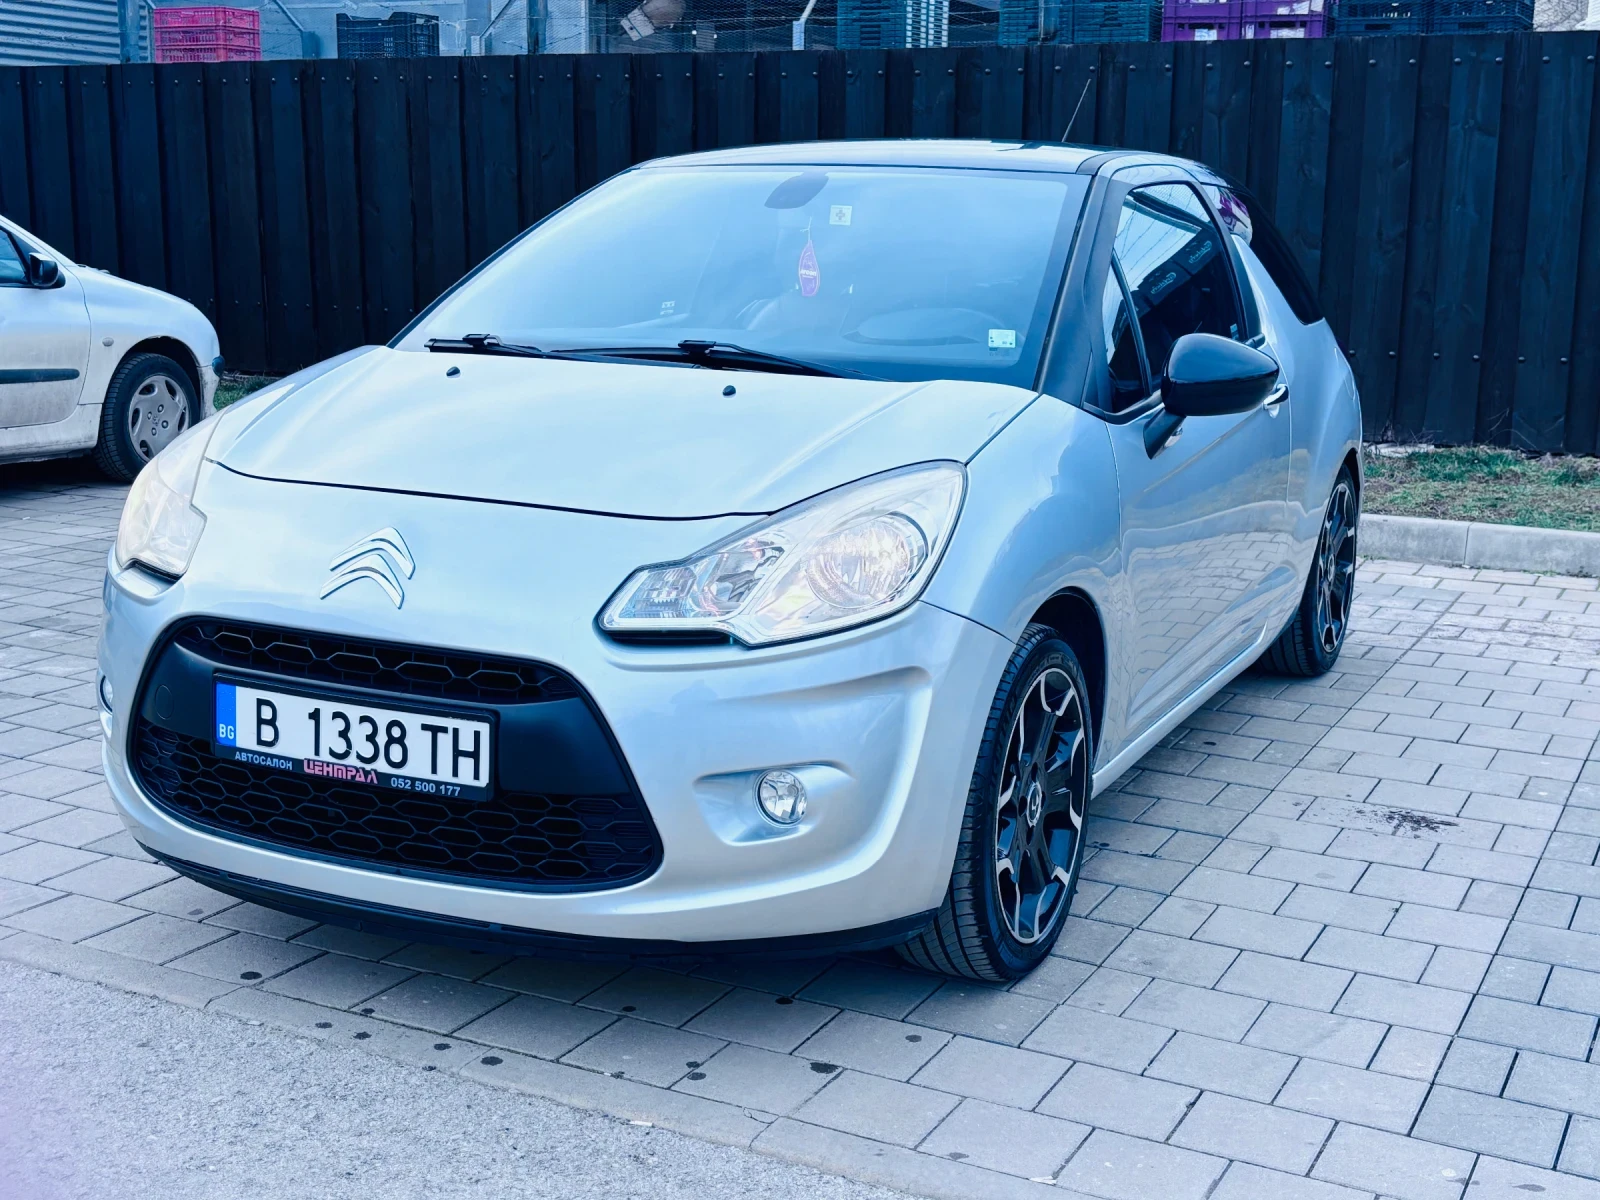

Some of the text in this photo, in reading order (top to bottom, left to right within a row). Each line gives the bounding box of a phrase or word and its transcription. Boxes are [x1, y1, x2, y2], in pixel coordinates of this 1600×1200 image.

[219, 723, 235, 740] BG
[256, 697, 481, 781] B 1338 TH
[234, 751, 293, 771] АВТОСАЛОН
[390, 777, 412, 790] 052
[414, 781, 436, 794] 500
[439, 784, 461, 797] 177
